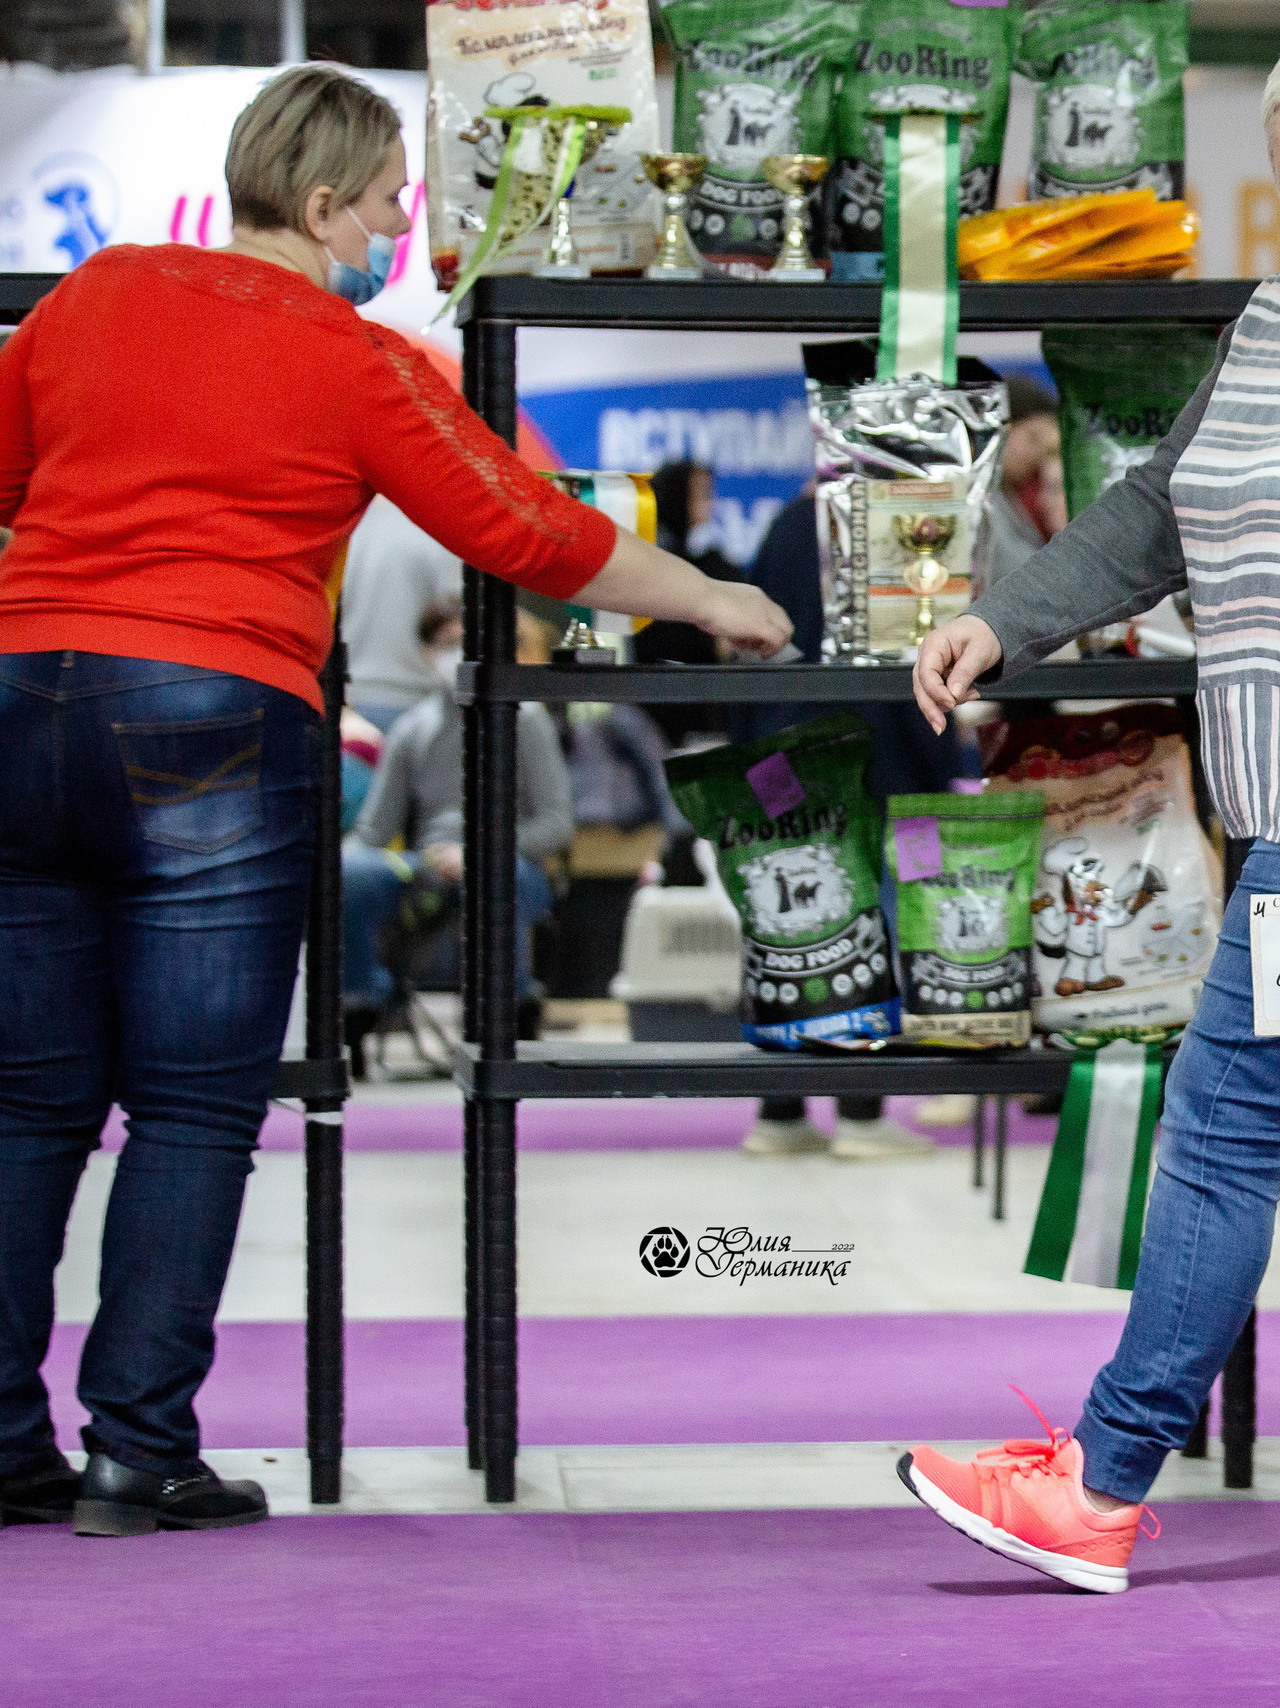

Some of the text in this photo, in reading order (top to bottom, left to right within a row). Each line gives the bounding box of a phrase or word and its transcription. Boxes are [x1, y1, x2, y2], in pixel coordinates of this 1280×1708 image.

[854, 41, 992, 90] ZooRing
[715, 804, 847, 851] ZooRing
[765, 939, 853, 970] DOG FOOD
